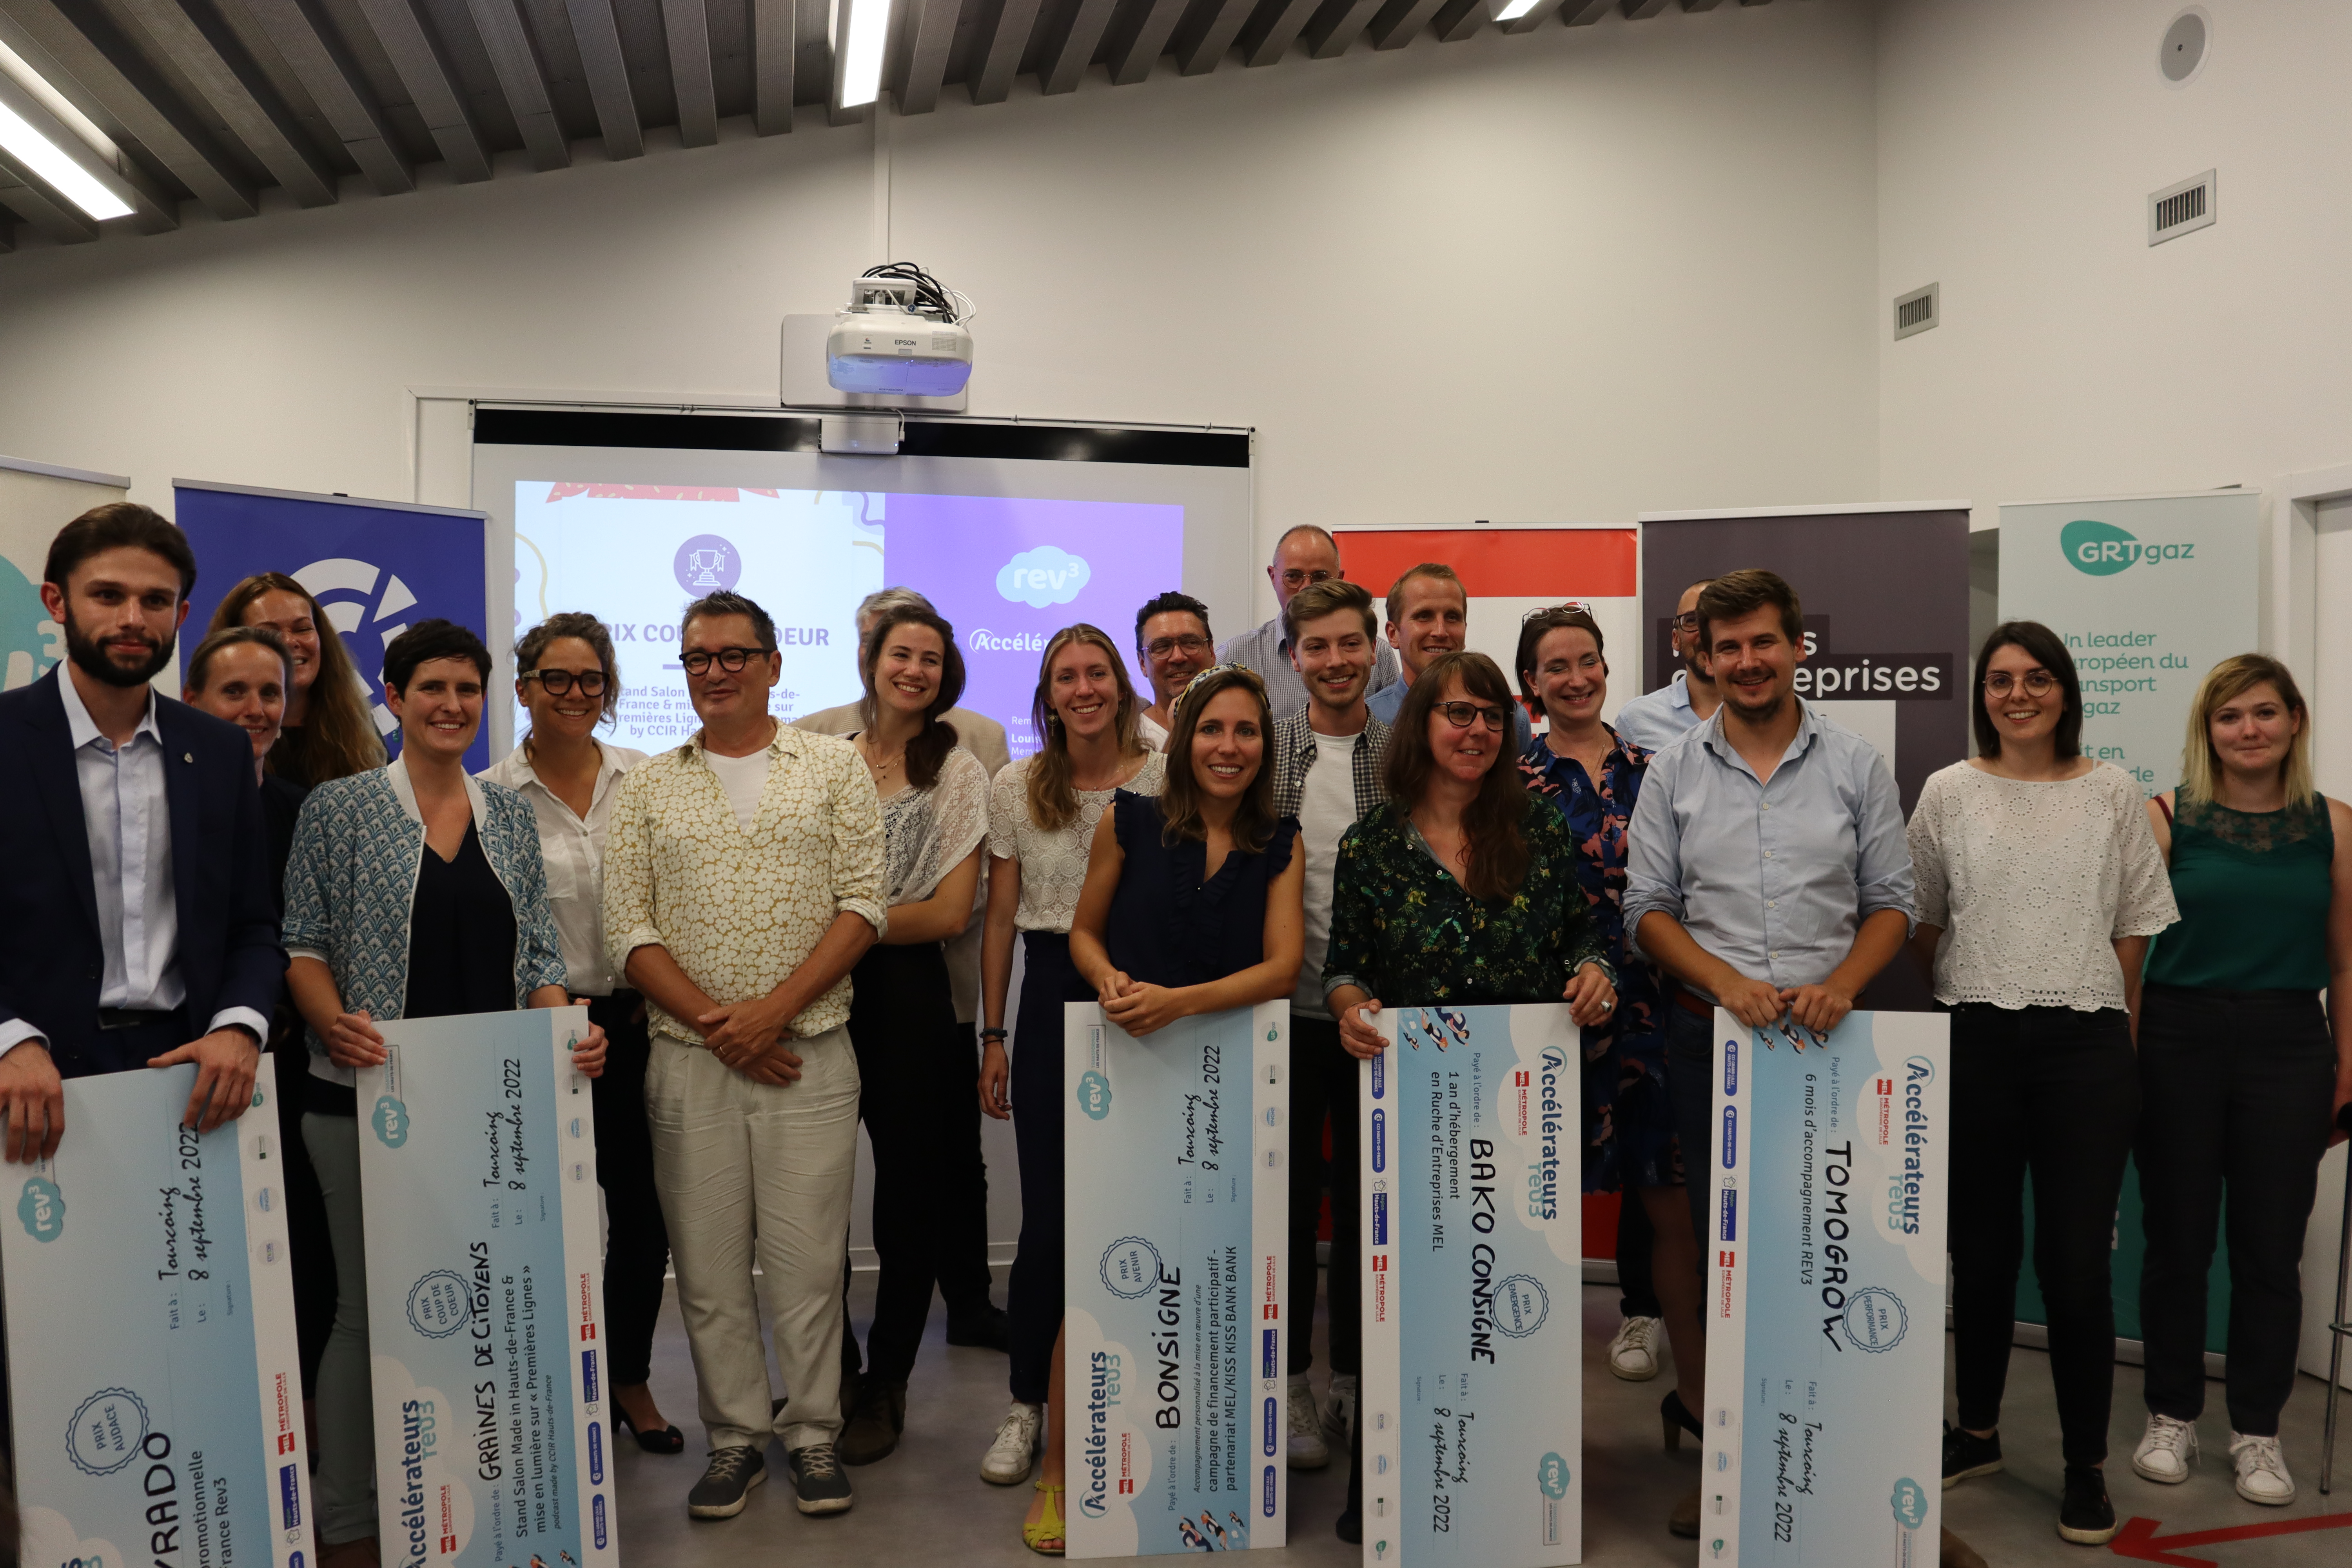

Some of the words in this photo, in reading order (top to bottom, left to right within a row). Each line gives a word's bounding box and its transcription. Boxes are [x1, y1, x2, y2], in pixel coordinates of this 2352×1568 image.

[2078, 540, 2195, 565] GRTgaz
[2088, 631, 2157, 648] leader
[2160, 652, 2189, 669] du
[619, 698, 659, 709] France
[663, 699, 672, 710] &
[775, 703, 794, 711] sur
[651, 686, 685, 697] Salon
[618, 711, 671, 723] remières
[2083, 702, 2121, 719] gaz
[630, 725, 644, 738] by
[648, 725, 677, 735] CCIR
[2098, 746, 2125, 760] en
[503, 1058, 523, 1099] 2022
[1202, 1045, 1220, 1085] 2022
[1431, 1072, 1439, 1087] en
[1471, 1053, 1481, 1072] Payé
[1449, 1082, 1457, 1097] an
[1804, 1085, 1816, 1116] mois
[1202, 1089, 1224, 1156] septembre
[1432, 1092, 1443, 1131] Ruche
[1474, 1112, 1480, 1122] de
[505, 1104, 530, 1176] septembre
[1178, 1094, 1201, 1165] Tourcoing
[1541, 1053, 1563, 1220] Accélérateurs
[483, 1111, 504, 1188] Tourcoing
[1202, 1160, 1219, 1171] 8
[1446, 1102, 1461, 1199] d'hébergement
[1904, 1062, 1929, 1235] Accélérateurs
[508, 1180, 526, 1191] 8
[1430, 1135, 1443, 1220] d'Entreprises
[1470, 1138, 1496, 1234] BAKO
[1800, 1120, 1817, 1247] d'accompagnement
[1206, 1193, 1213, 1203] Le
[158, 1187, 181, 1281] Tourcoing
[182, 1176, 212, 1262] septembre
[1432, 1224, 1443, 1252] MEL
[1821, 1140, 1852, 1352] TOMOGROW
[188, 1269, 210, 1281] 8
[501, 1275, 513, 1284] &
[1118, 1258, 1129, 1279] PRIX
[1129, 1250, 1143, 1283] AVENIR
[1225, 1247, 1236, 1281] BANK
[1801, 1251, 1813, 1285] REV3
[431, 1283, 441, 1296] DE
[445, 1283, 459, 1316] COEUR
[523, 1277, 536, 1319] Lignes
[580, 1273, 588, 1322] MÉTROPOLE
[1207, 1256, 1221, 1327] participatif
[1225, 1286, 1236, 1321] BANK
[1521, 1294, 1532, 1316] PRIX
[420, 1296, 432, 1320] PRIX
[432, 1298, 448, 1325] COUP
[1508, 1283, 1523, 1332] EMERGENCE
[1863, 1295, 1879, 1346] PERFORMANCE
[1878, 1308, 1889, 1330] PRIX
[504, 1289, 519, 1398] Hauts-de-France
[1196, 1332, 1201, 1342] en
[1225, 1325, 1236, 1353] KISS
[474, 1344, 495, 1367] DE
[524, 1324, 537, 1389] Premières
[1207, 1330, 1218, 1408] financement
[1224, 1357, 1236, 1418] MEL/KISS
[1439, 1375, 1446, 1384] Le
[275, 1373, 287, 1432] MÉTROPOLE
[509, 1403, 520, 1415] in
[530, 1405, 539, 1426] sur
[545, 1375, 554, 1440] Hauts-de-France
[1193, 1377, 1202, 1426] personnalisé
[1434, 1408, 1451, 1418] 8
[91, 1421, 107, 1450] PRIX
[104, 1403, 125, 1452] AUDACE
[1085, 1351, 1107, 1511] Accélérateurs
[1207, 1412, 1218, 1426] de
[1779, 1413, 1797, 1425] 8
[509, 1419, 523, 1454] Made
[548, 1442, 556, 1461] CCIR
[1168, 1445, 1176, 1454] de
[1452, 1412, 1474, 1484] Tourcoing
[529, 1430, 543, 1479] lumière
[549, 1463, 558, 1473] by
[1167, 1457, 1176, 1483] l'ordre
[1193, 1426, 1202, 1493] Accompagnement
[1209, 1430, 1221, 1492] campagne
[1225, 1423, 1238, 1490] partenariat
[1429, 1421, 1450, 1490] septembre
[1773, 1428, 1795, 1497] septembre
[1796, 1423, 1822, 1495] Tourcoing
[512, 1459, 525, 1495] Salon
[535, 1483, 544, 1499] en
[214, 1477, 229, 1516] Rev3
[552, 1498, 561, 1529] podcast
[1168, 1492, 1177, 1510] Payé
[1433, 1494, 1450, 1533] 2022
[514, 1499, 528, 1537] Stand
[534, 1503, 546, 1532] mise
[1774, 1501, 1792, 1543] 2022
